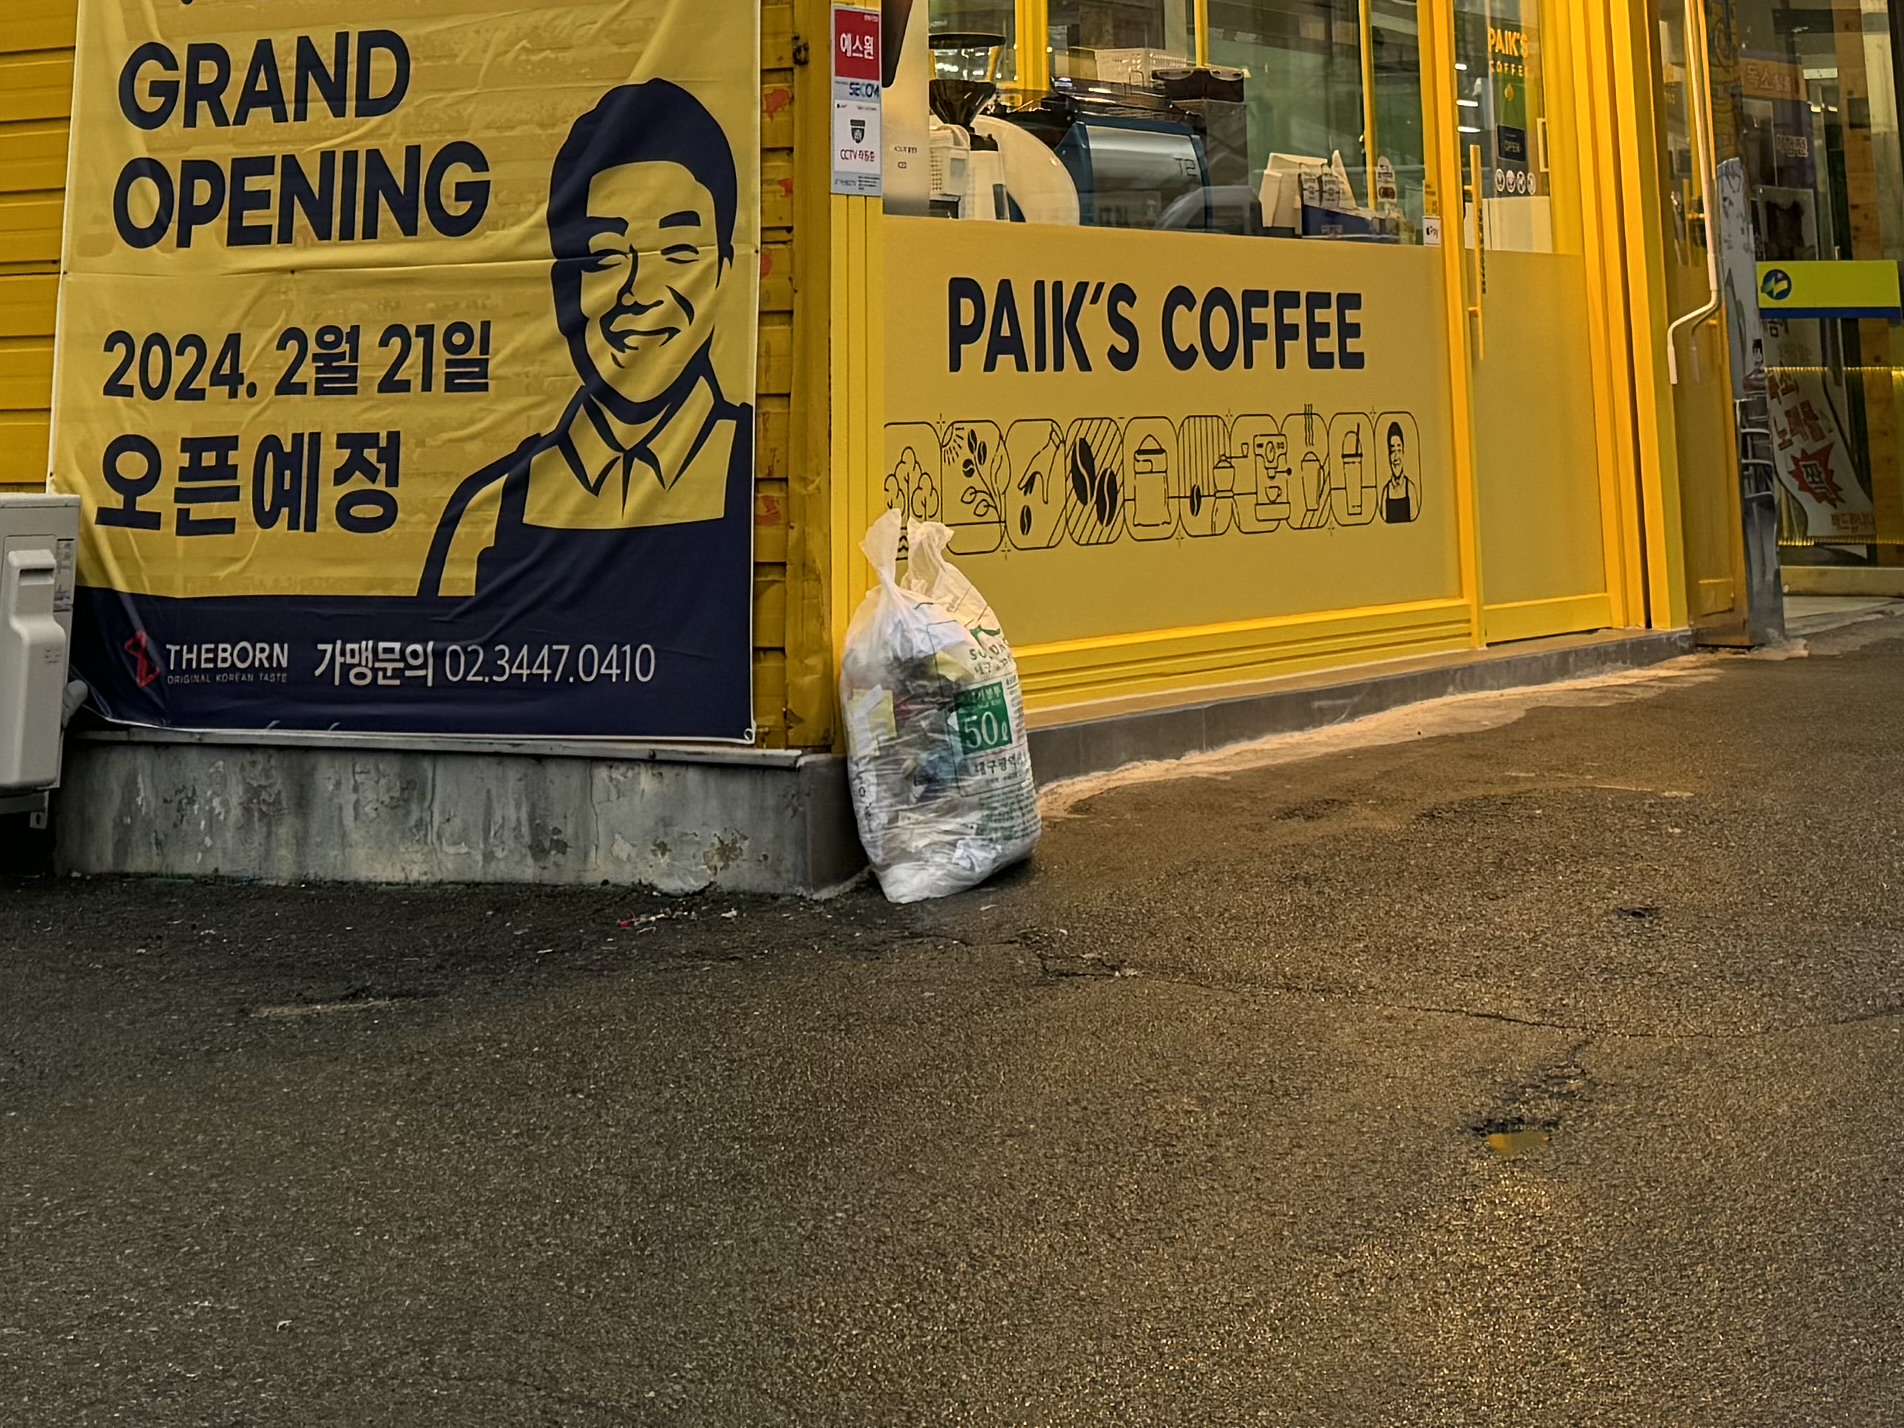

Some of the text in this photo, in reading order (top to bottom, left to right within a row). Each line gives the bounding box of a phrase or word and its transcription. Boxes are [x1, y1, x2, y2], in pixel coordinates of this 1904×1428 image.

[839, 33, 875, 60] 에스원
[1488, 27, 1529, 59] PAIK'S
[119, 29, 412, 132] GRAND
[113, 141, 491, 250] OPENING
[948, 276, 1366, 373] PAIK'S COFFEE
[102, 319, 492, 401] 2024. 2월 21일
[94, 429, 401, 538] 오픈예정
[166, 641, 289, 671] THEBORN
[166, 672, 288, 685] ORIGINAL KOREAN TASTE
[313, 640, 656, 687] 가맹문의 02.3447.0410
